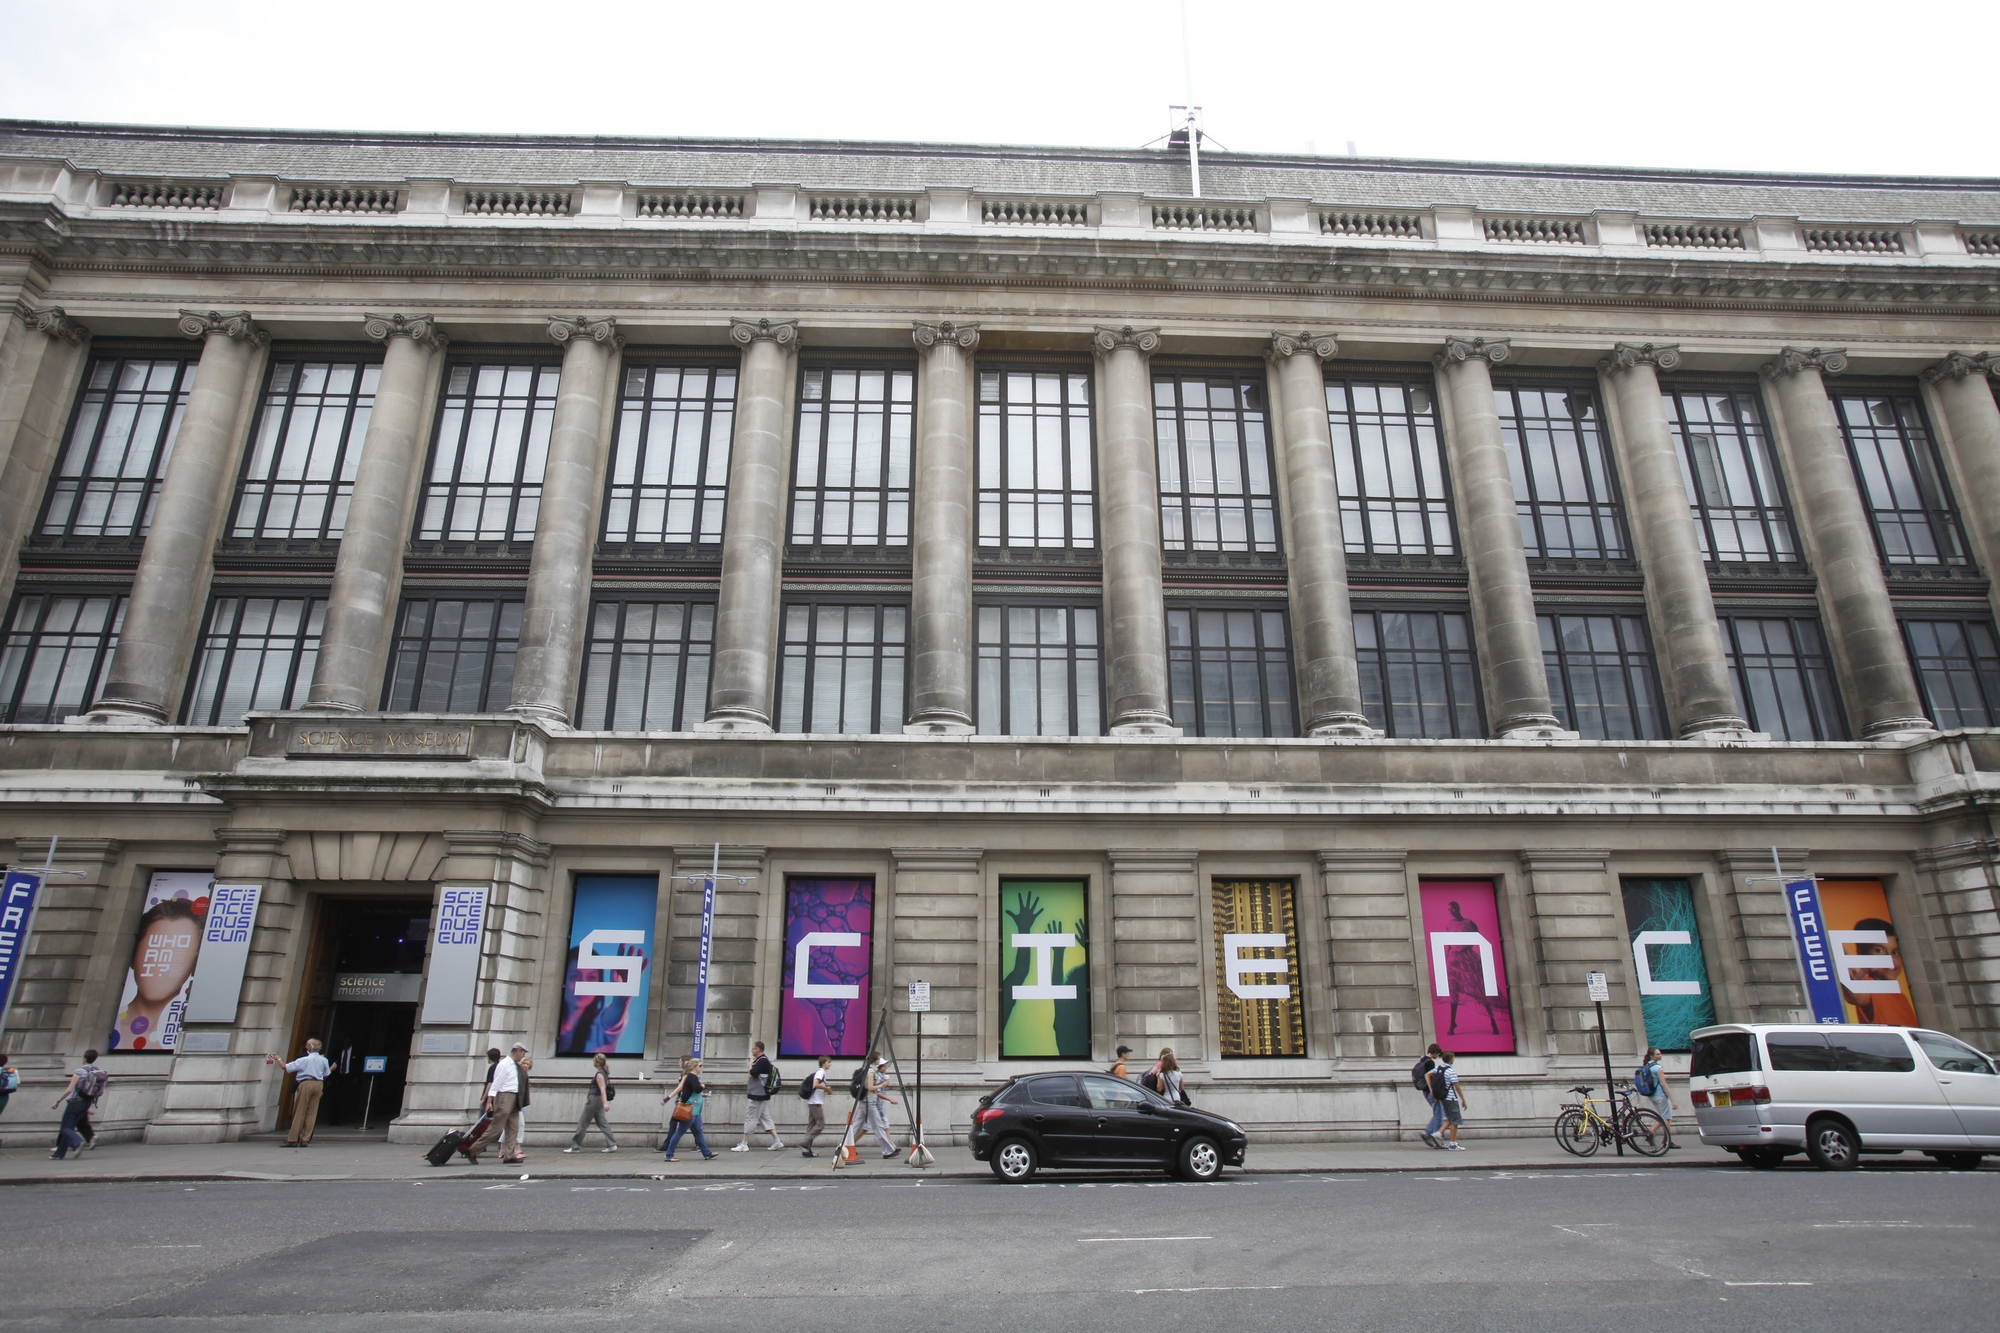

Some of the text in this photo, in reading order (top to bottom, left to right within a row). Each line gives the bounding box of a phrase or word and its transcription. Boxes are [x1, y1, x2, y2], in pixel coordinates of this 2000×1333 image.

[298, 731, 462, 747] SCIENCE MUSEUM
[148, 934, 191, 948] WHO
[1794, 888, 1829, 981] FREE
[144, 949, 173, 962] AM
[140, 963, 170, 977] I?
[340, 975, 386, 986] science
[338, 987, 384, 995] museum
